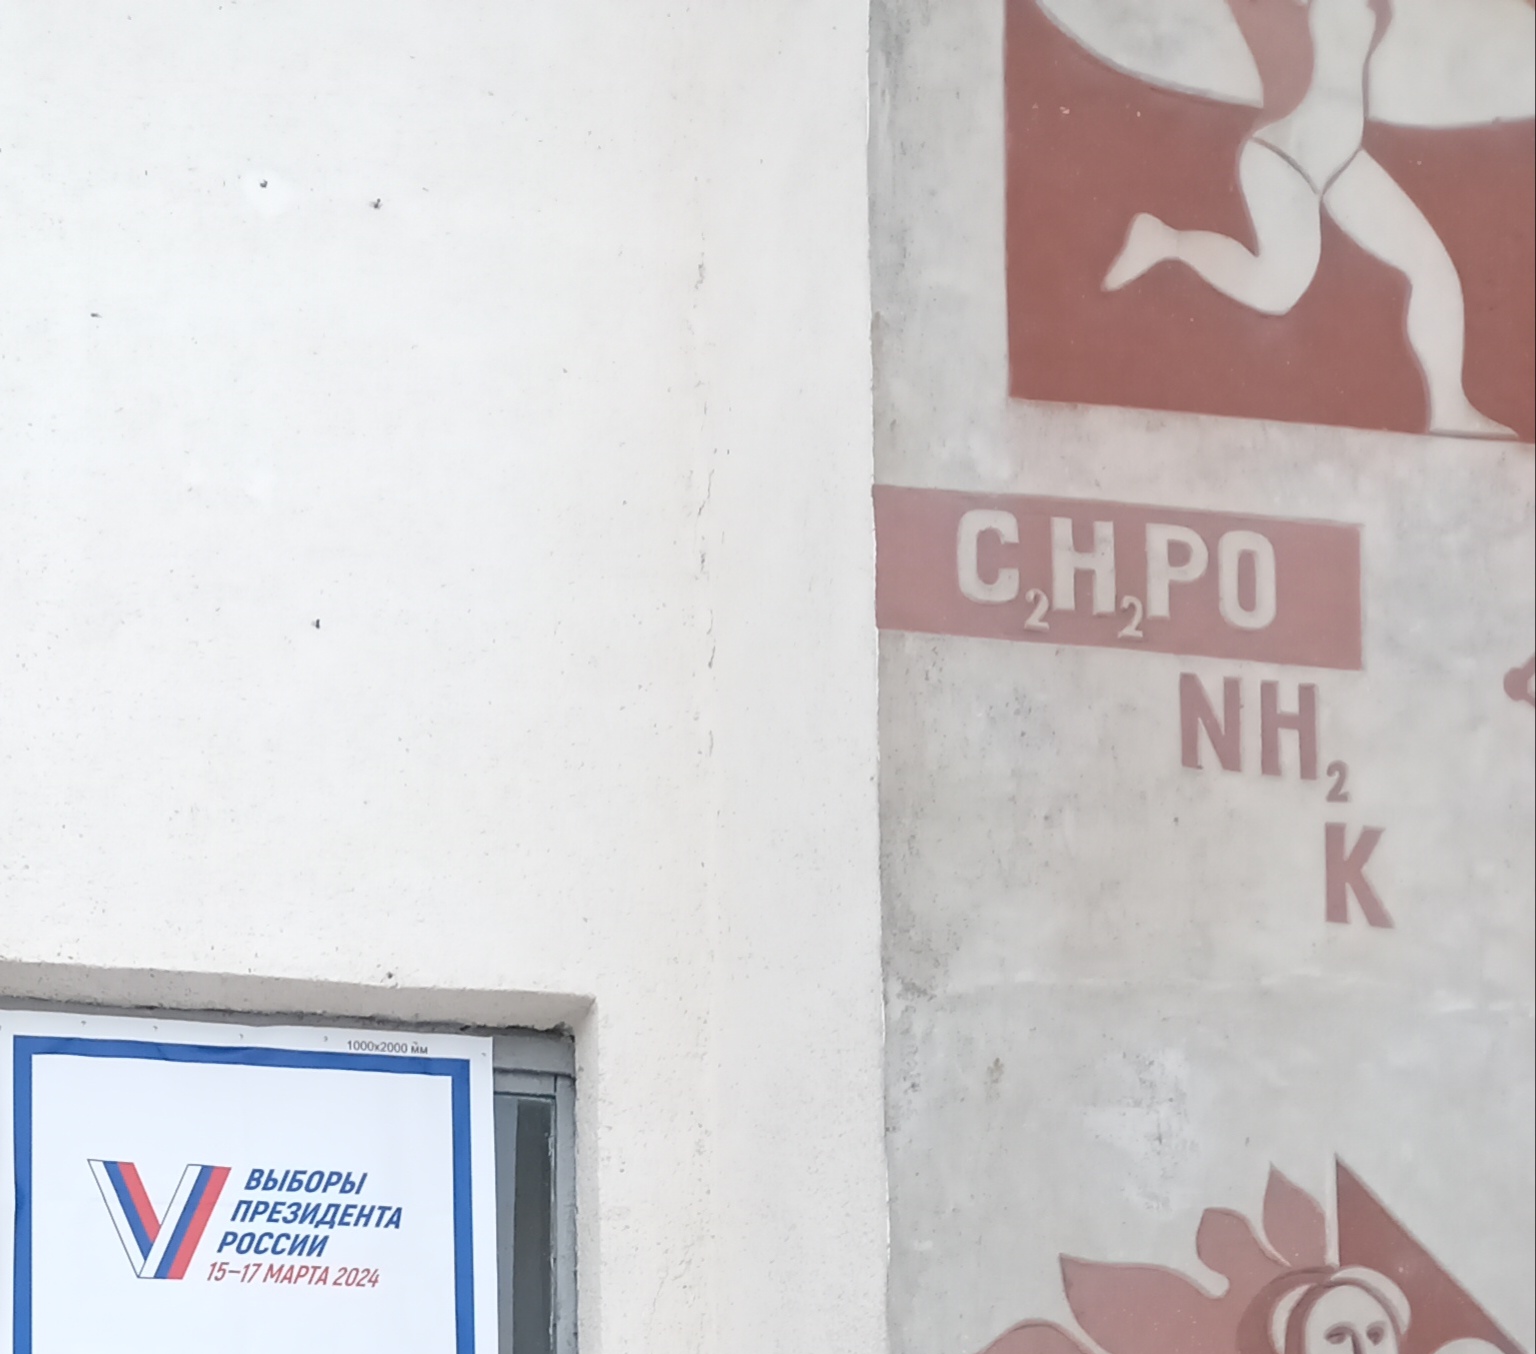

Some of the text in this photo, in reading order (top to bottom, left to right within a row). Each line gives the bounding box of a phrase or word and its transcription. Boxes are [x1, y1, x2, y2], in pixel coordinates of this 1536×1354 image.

[1323, 821, 1396, 929] K
[244, 1168, 368, 1195] ВЫБОРЫ
[230, 1200, 403, 1229] ПРЕЗИДЕНТА
[216, 1231, 330, 1258] РОССИИ
[263, 1264, 329, 1286] МАРТА
[332, 1267, 380, 1288] 2024
